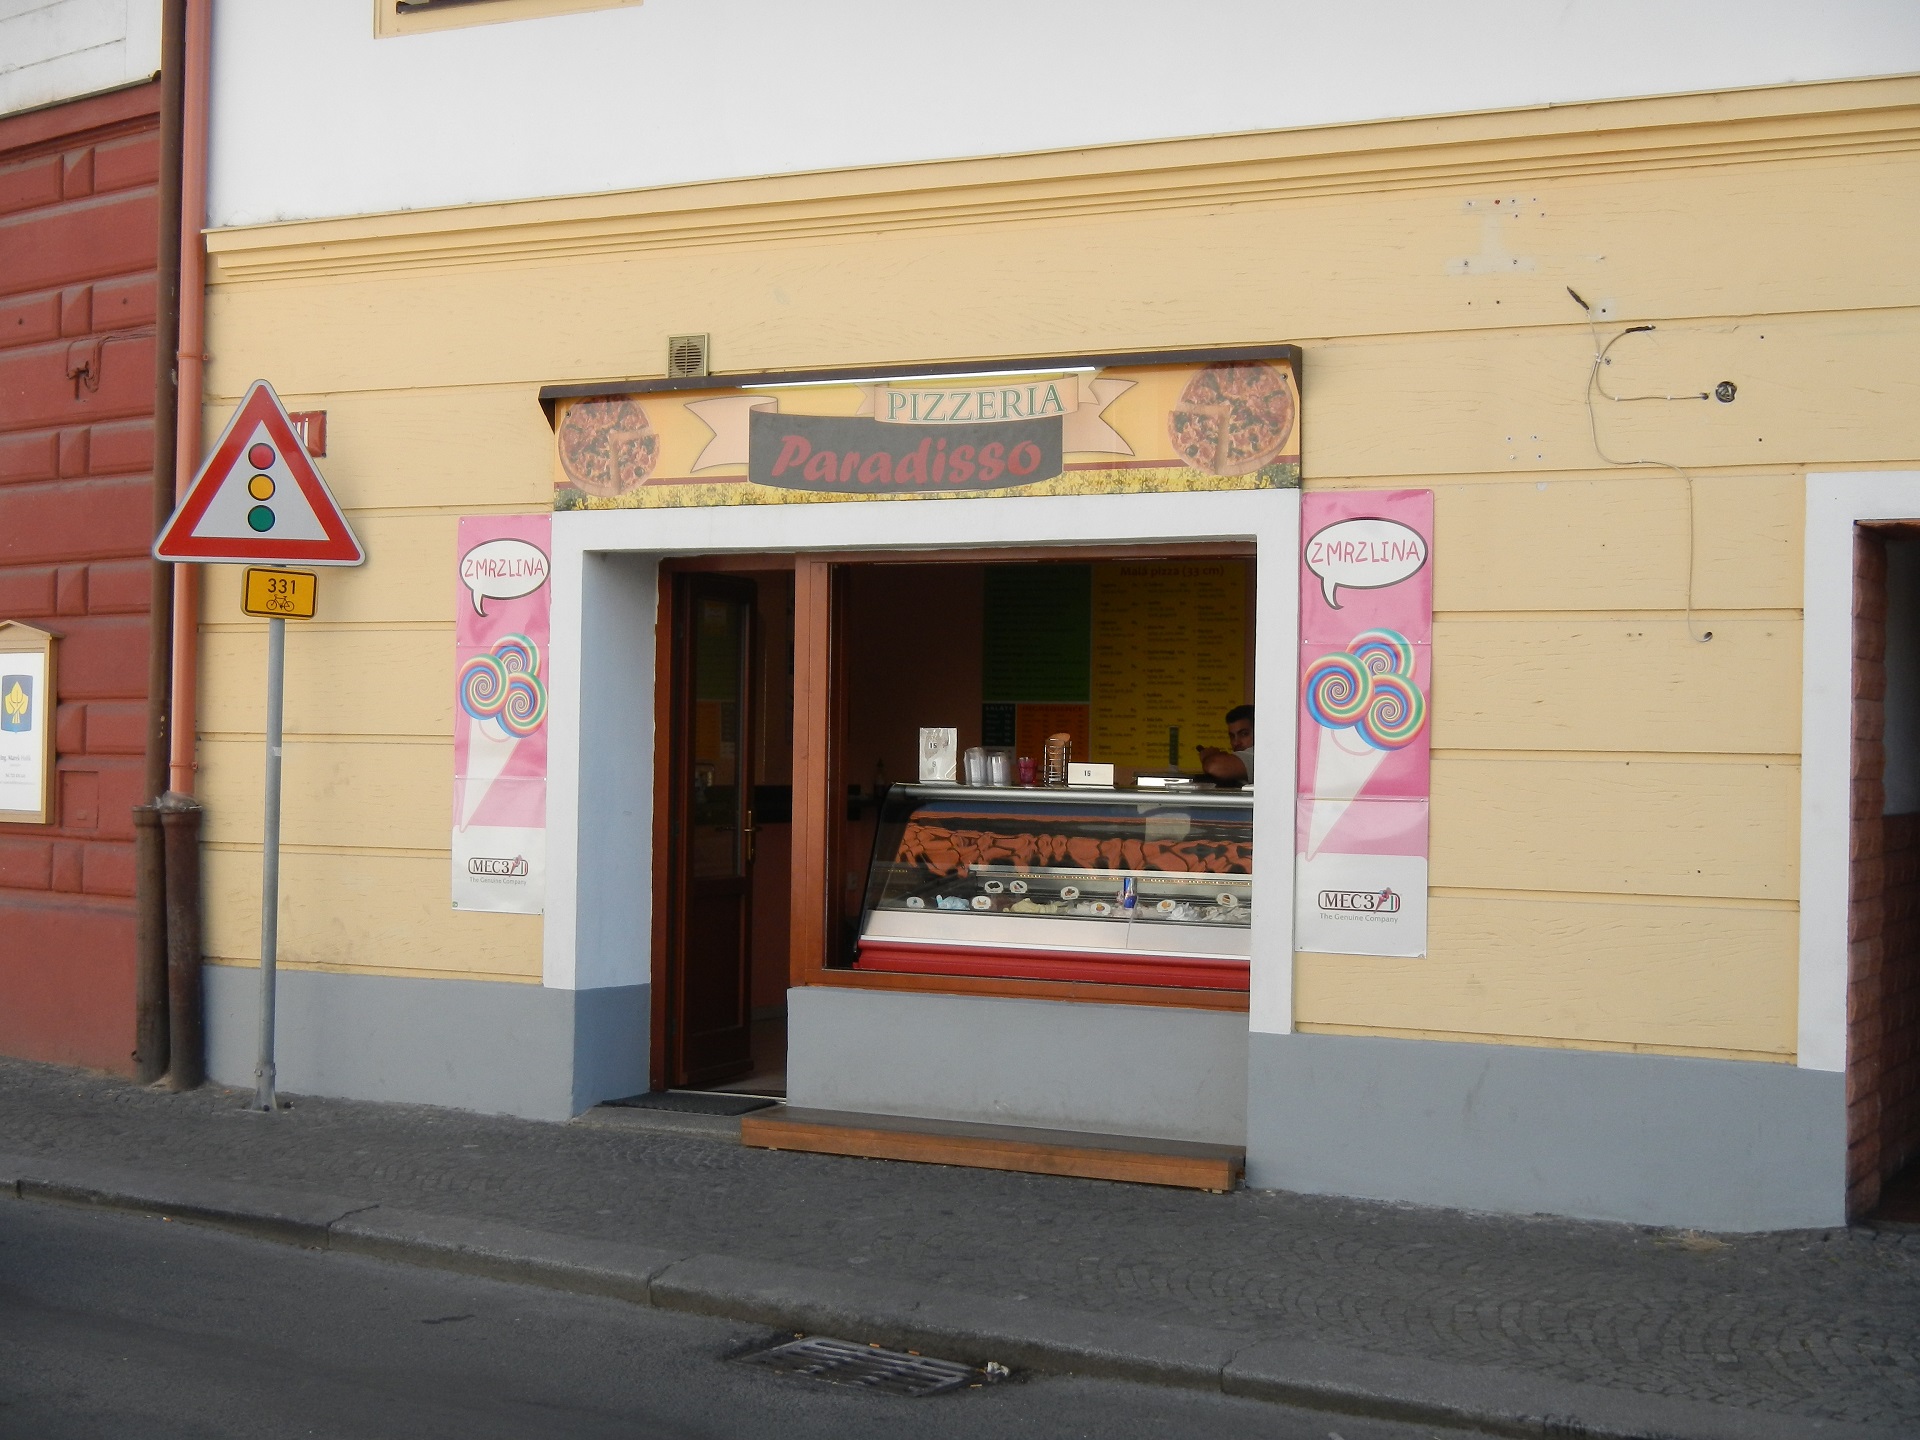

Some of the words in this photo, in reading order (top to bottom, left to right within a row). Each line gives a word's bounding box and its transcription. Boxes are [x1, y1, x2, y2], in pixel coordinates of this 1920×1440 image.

[887, 384, 1066, 421] PIZZERIA
[771, 434, 1042, 484] Paradisso
[1311, 539, 1421, 566] ZMRZLINA
[464, 558, 545, 580] ZMRZLINA
[1120, 566, 1147, 576] Malá
[1151, 566, 1179, 578] pizza
[1203, 564, 1225, 577] cm)
[267, 578, 296, 594] 331
[473, 859, 510, 874] MEC3
[502, 878, 527, 886] Company
[1324, 893, 1375, 909] MEC3
[1334, 913, 1363, 922] Genuine
[1365, 914, 1399, 924] Company
